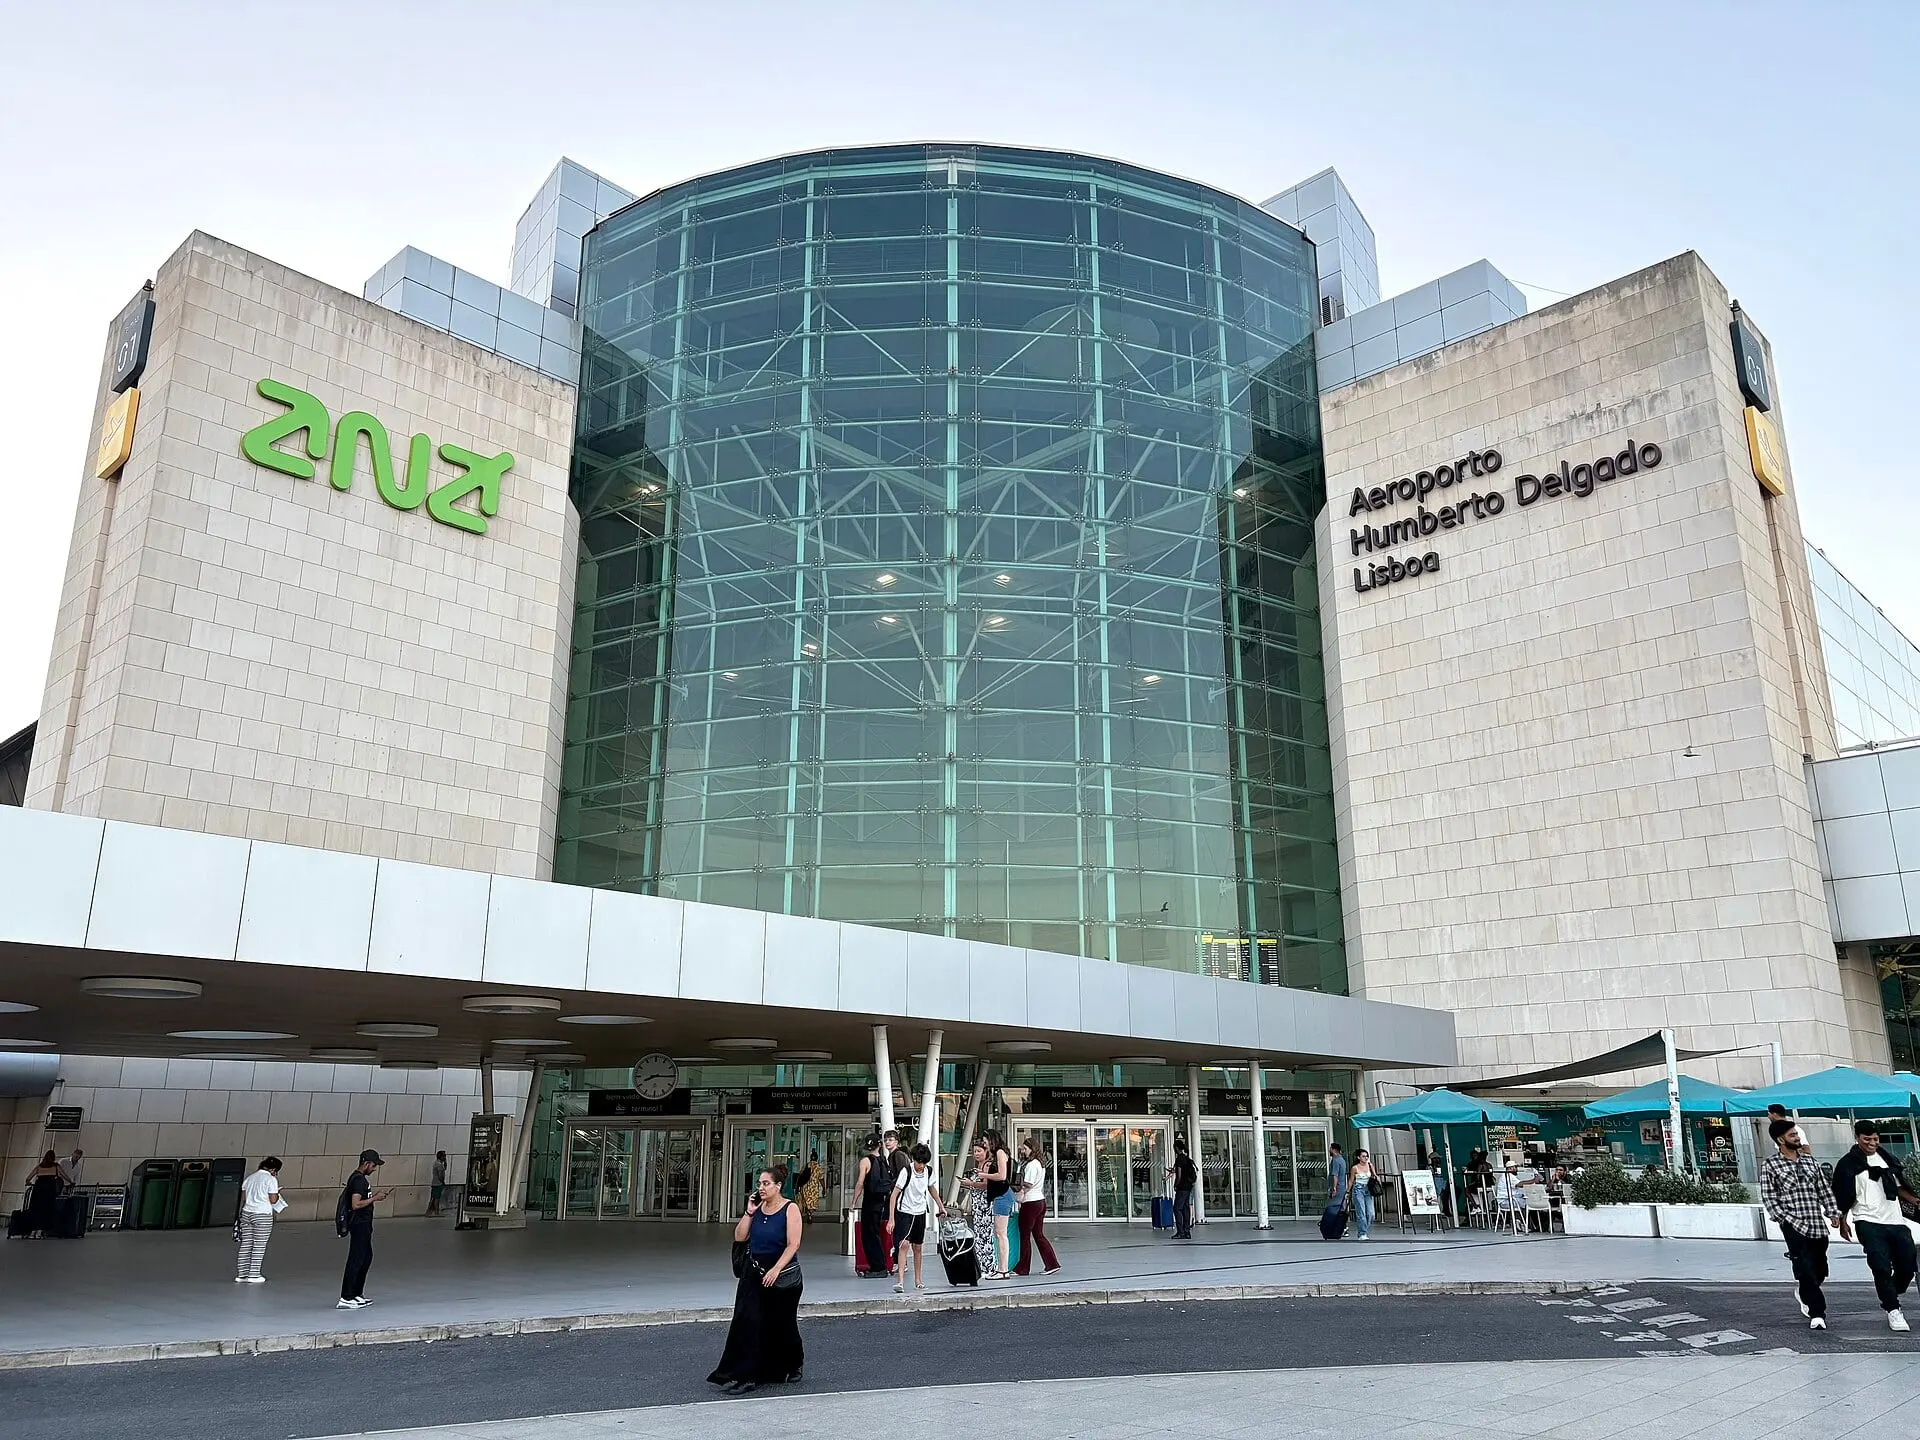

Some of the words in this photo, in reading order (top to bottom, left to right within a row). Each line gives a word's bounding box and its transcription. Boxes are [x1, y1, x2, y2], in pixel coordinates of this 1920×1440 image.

[1349, 449, 1503, 517] Aeroporto
[1350, 491, 1505, 556] Humberto
[1514, 438, 1663, 507] Delgado
[1353, 551, 1440, 593] Lisboa
[631, 1104, 659, 1112] terminal
[801, 1103, 832, 1111] terminal
[1082, 1103, 1113, 1111] terminal
[1566, 1114, 1586, 1128] My
[468, 1195, 489, 1203] CENTURY
